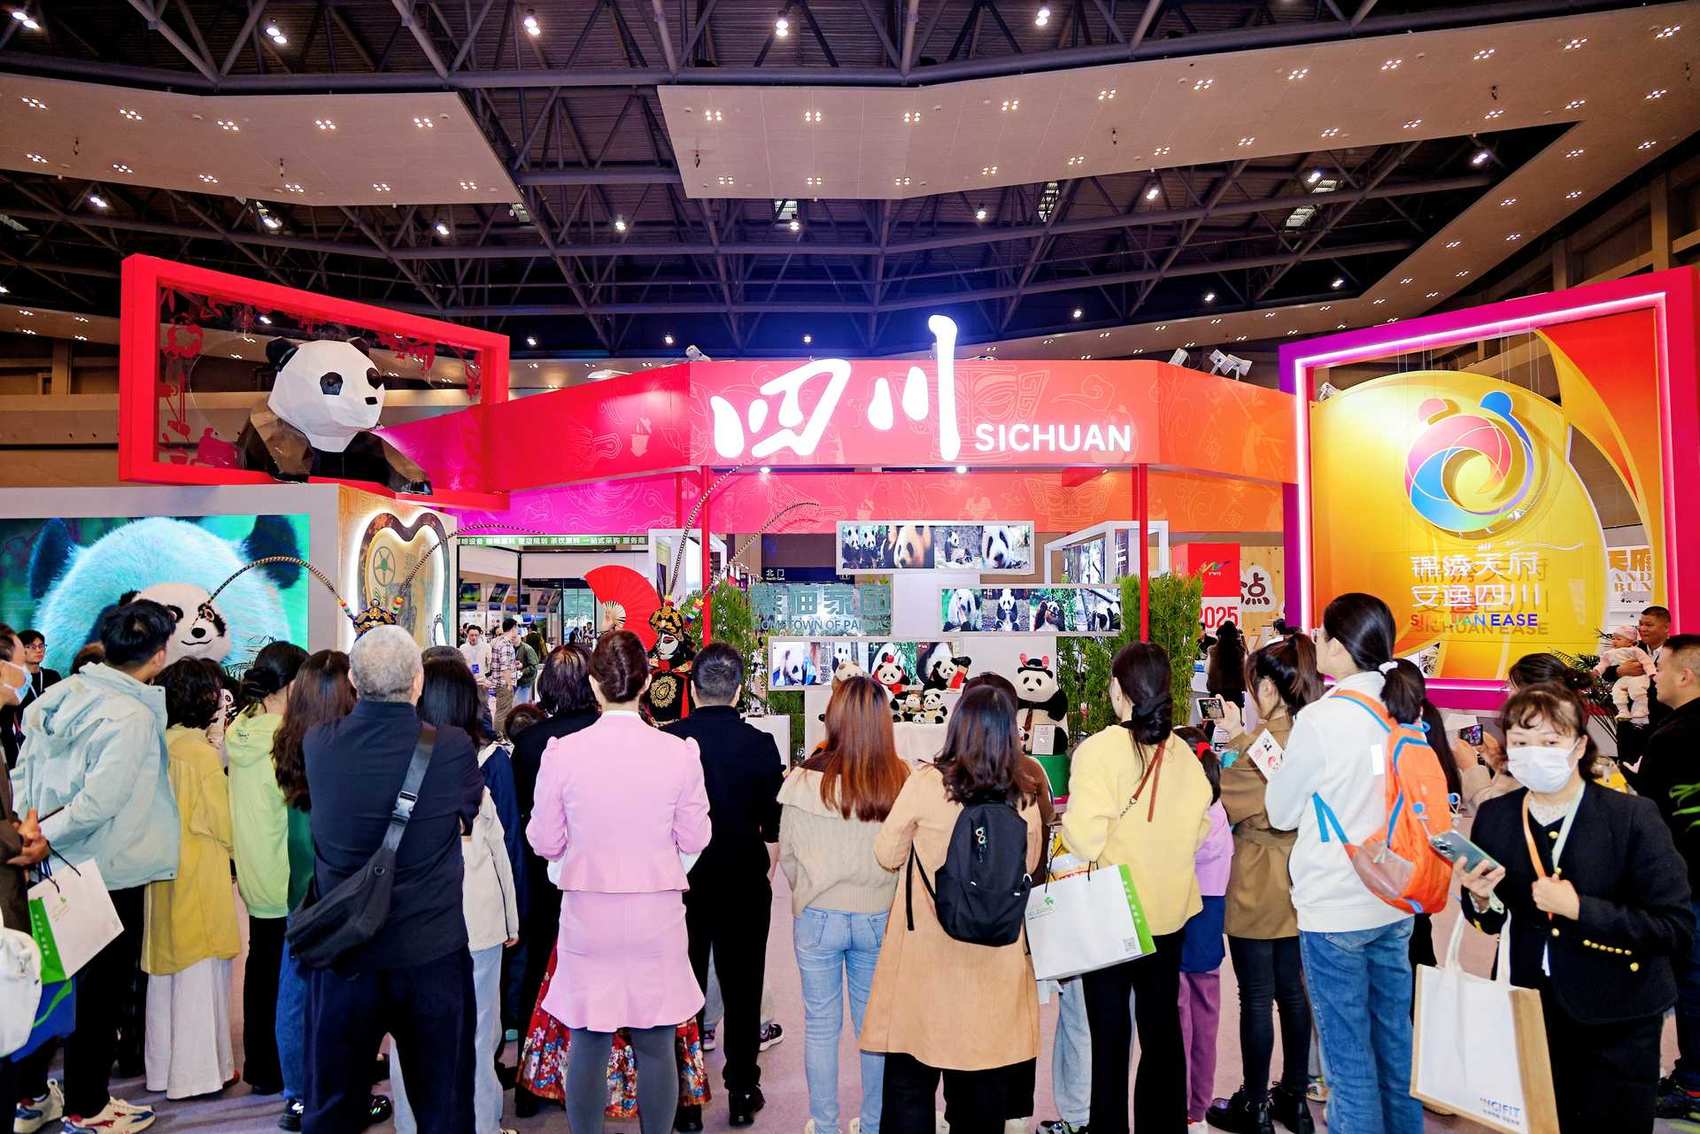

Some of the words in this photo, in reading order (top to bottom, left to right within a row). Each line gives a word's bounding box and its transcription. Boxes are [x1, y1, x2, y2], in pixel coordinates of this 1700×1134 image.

[710, 313, 961, 461] 四川
[974, 423, 1132, 453] SICHUAN
[1410, 584, 1540, 608] 安逸四川
[825, 620, 841, 631] OF
[1490, 613, 1539, 627] EASE
